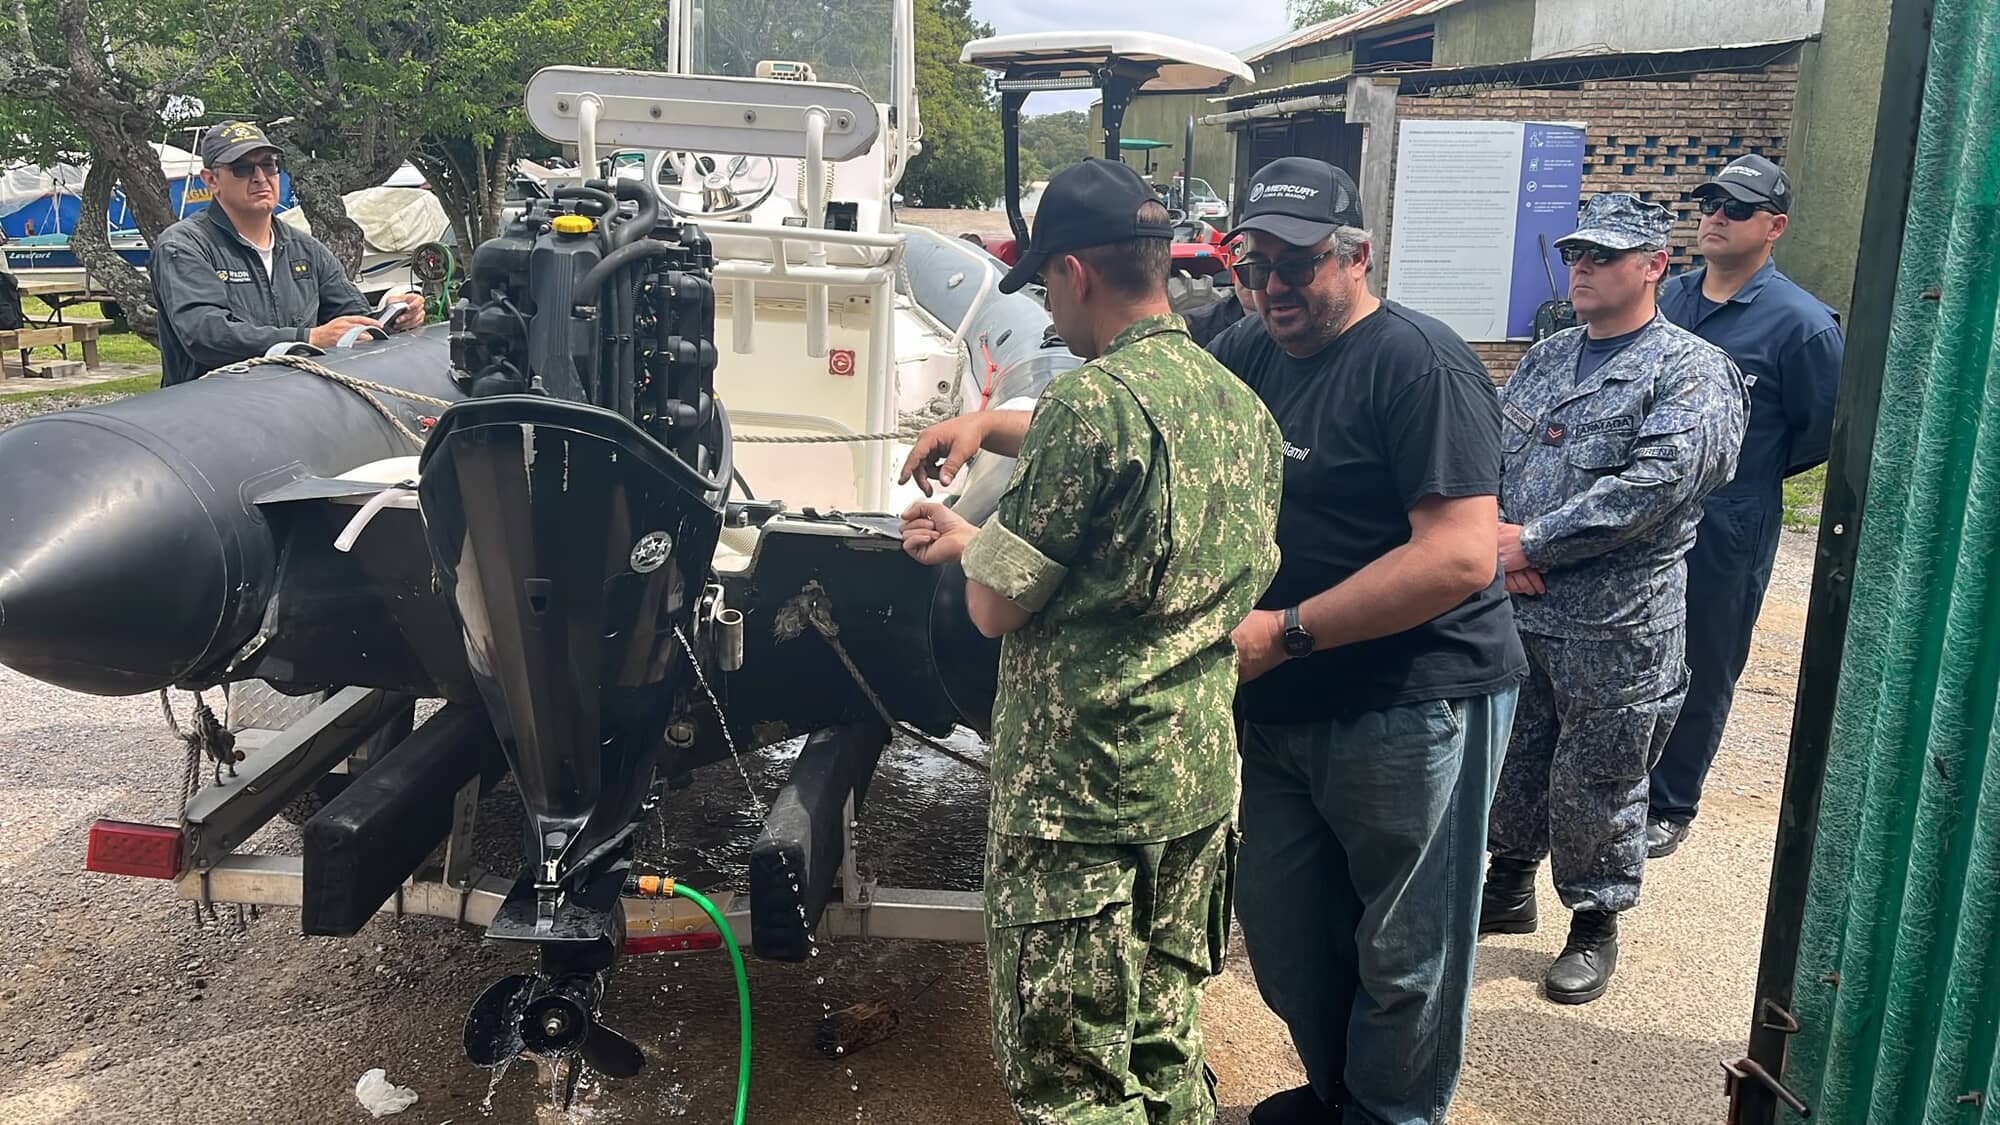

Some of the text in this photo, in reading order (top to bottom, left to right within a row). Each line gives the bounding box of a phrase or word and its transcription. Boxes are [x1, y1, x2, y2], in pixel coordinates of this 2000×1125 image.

[1264, 184, 1320, 197] MERCURY
[1580, 416, 1631, 435] ARMADA
[1281, 440, 1311, 461] illamil
